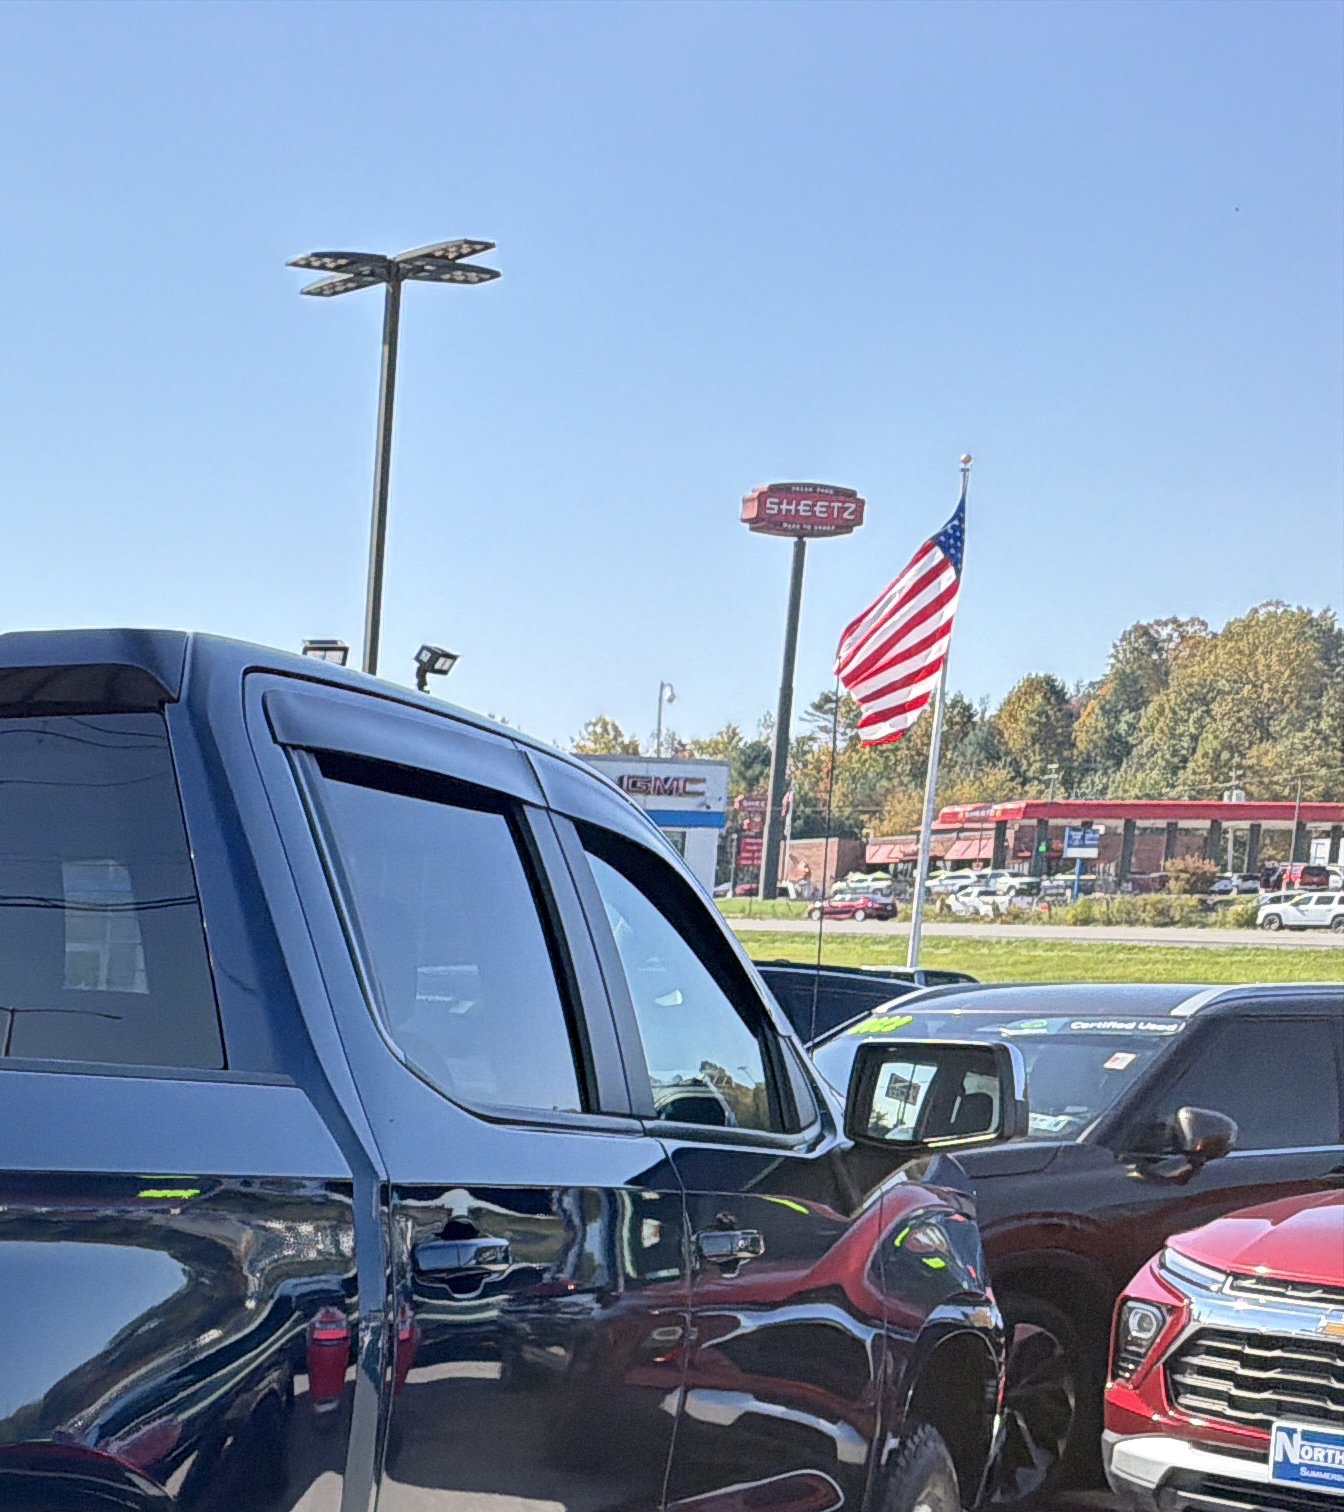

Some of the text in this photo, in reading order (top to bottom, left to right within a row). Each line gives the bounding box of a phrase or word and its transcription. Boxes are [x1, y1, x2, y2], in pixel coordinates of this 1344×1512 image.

[765, 498, 857, 520] SHEETZ
[618, 775, 707, 797] GMC
[1071, 1021, 1179, 1032] Certified Used
